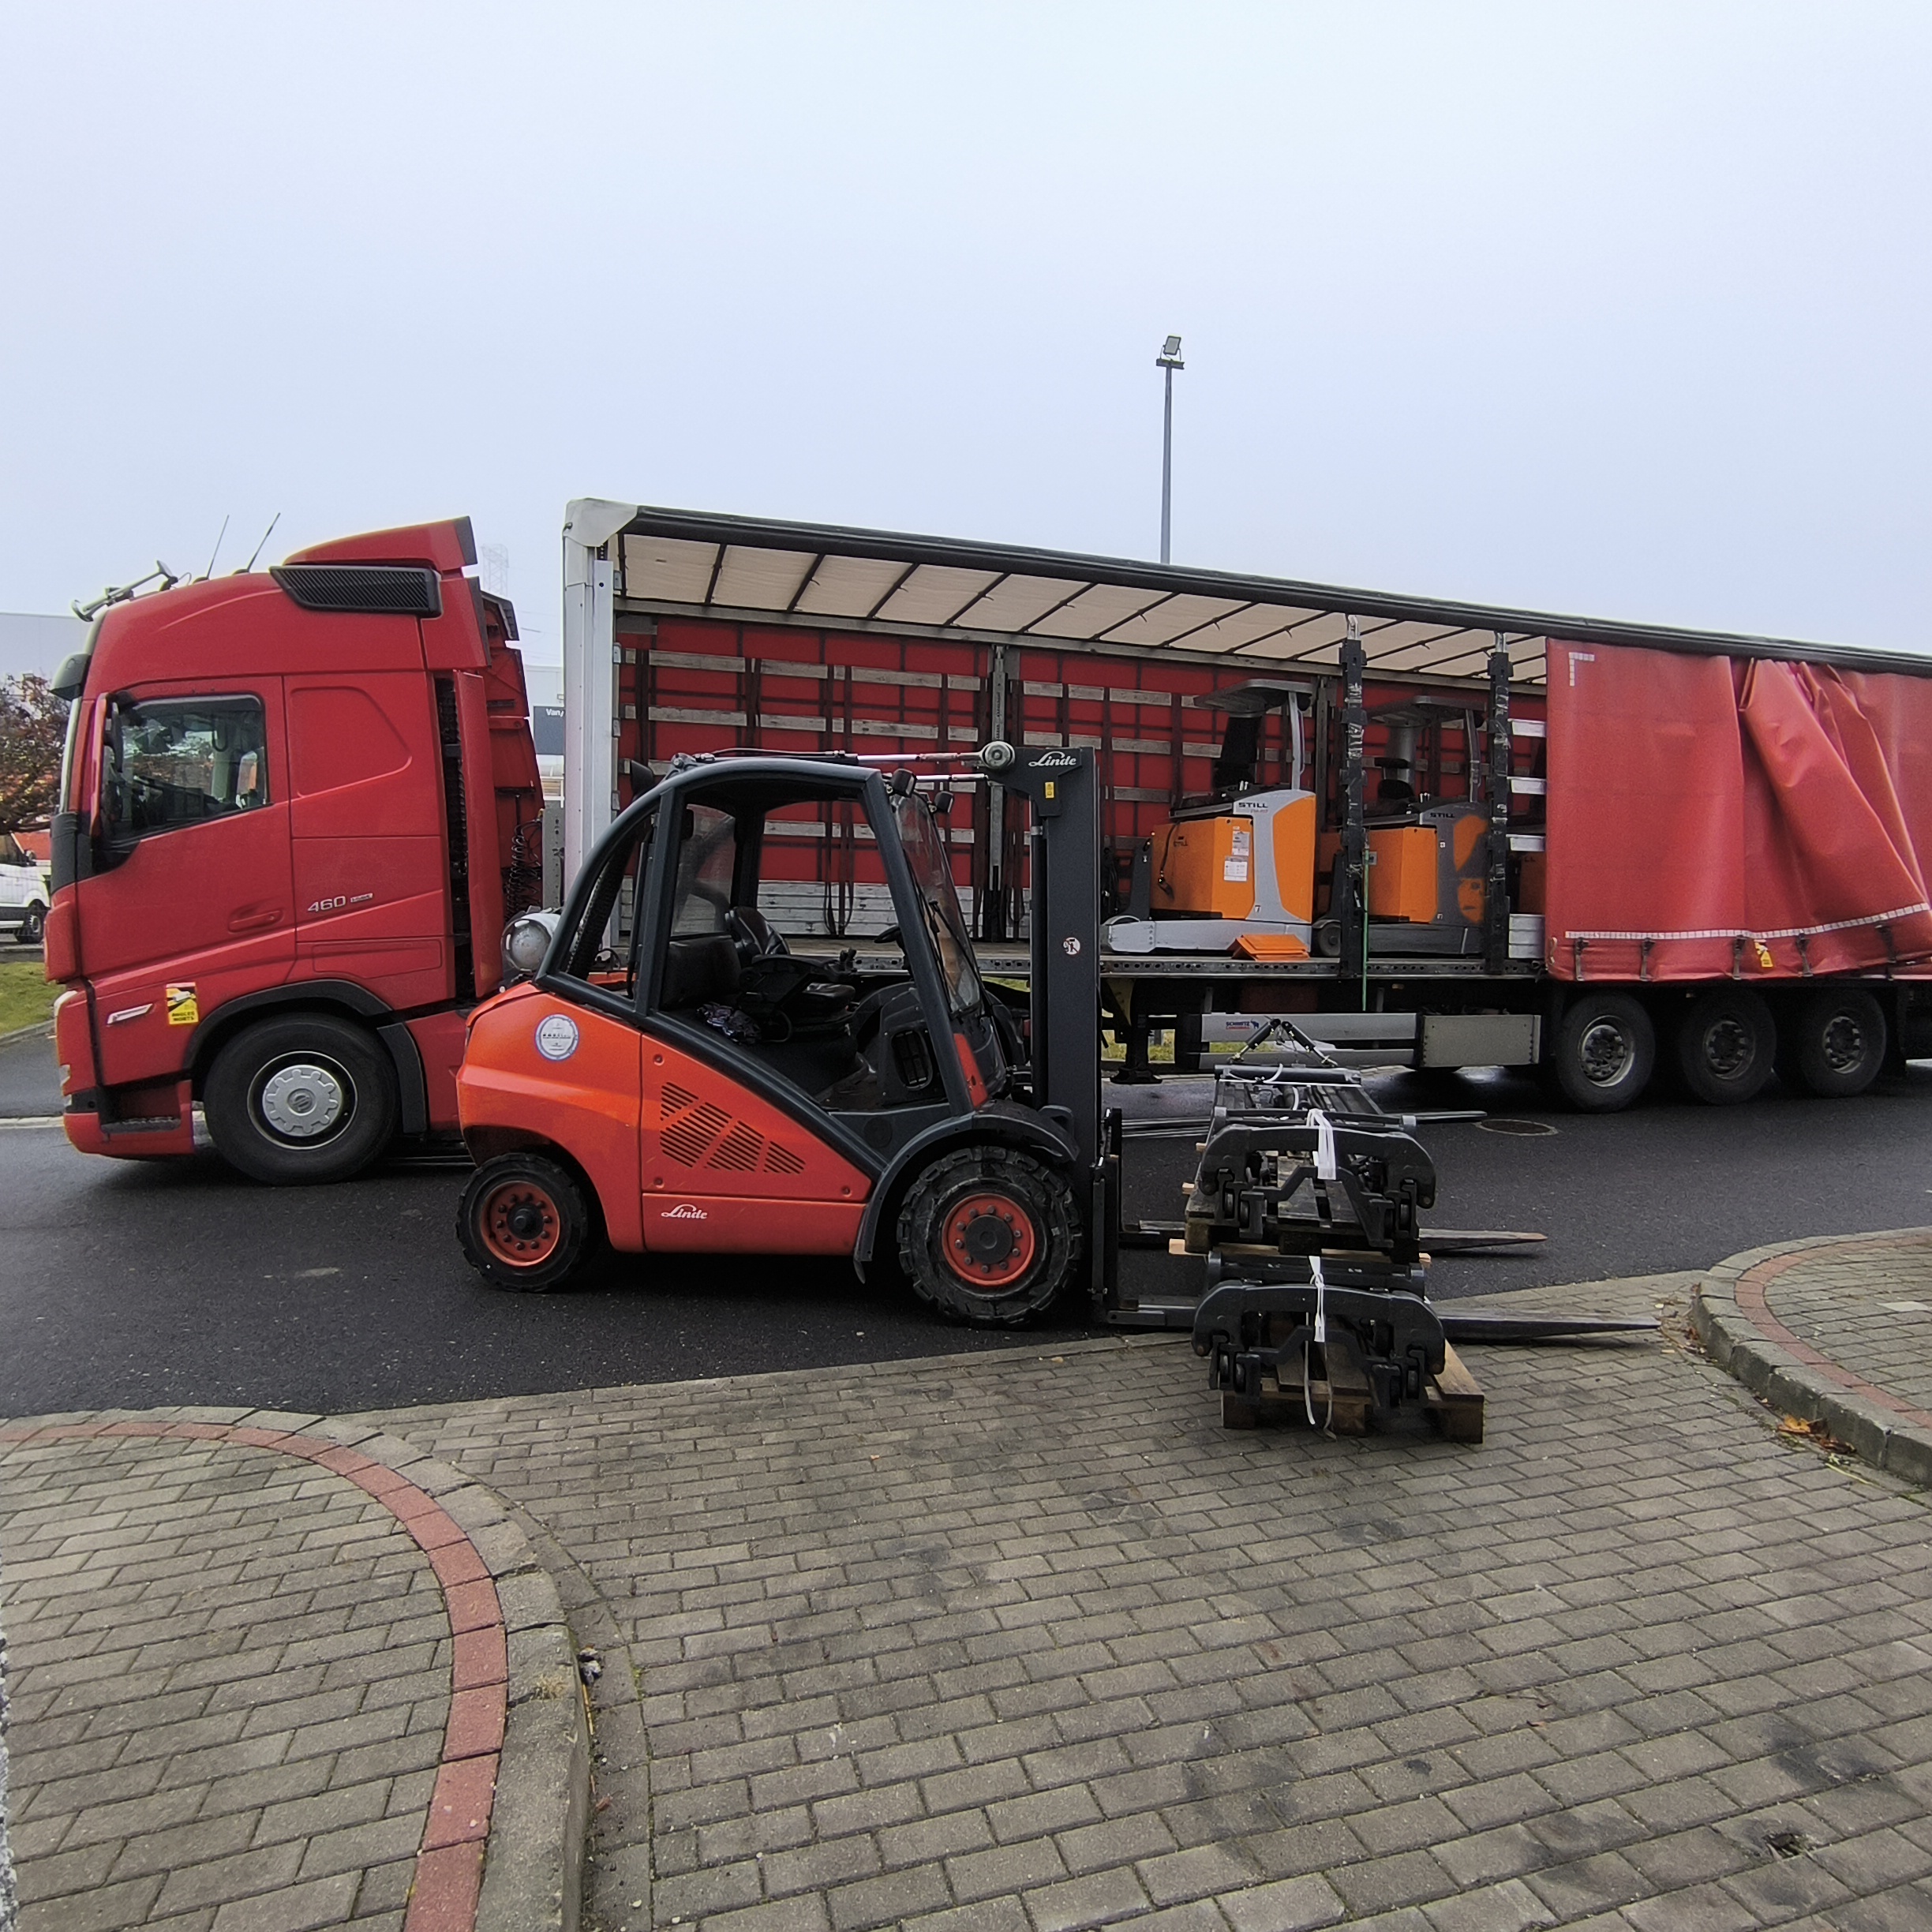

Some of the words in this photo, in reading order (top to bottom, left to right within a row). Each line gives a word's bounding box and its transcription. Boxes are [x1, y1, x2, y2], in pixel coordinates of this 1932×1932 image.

[1028, 751, 1076, 766] Linde
[308, 896, 346, 912] 460
[661, 1204, 708, 1219] Linde
